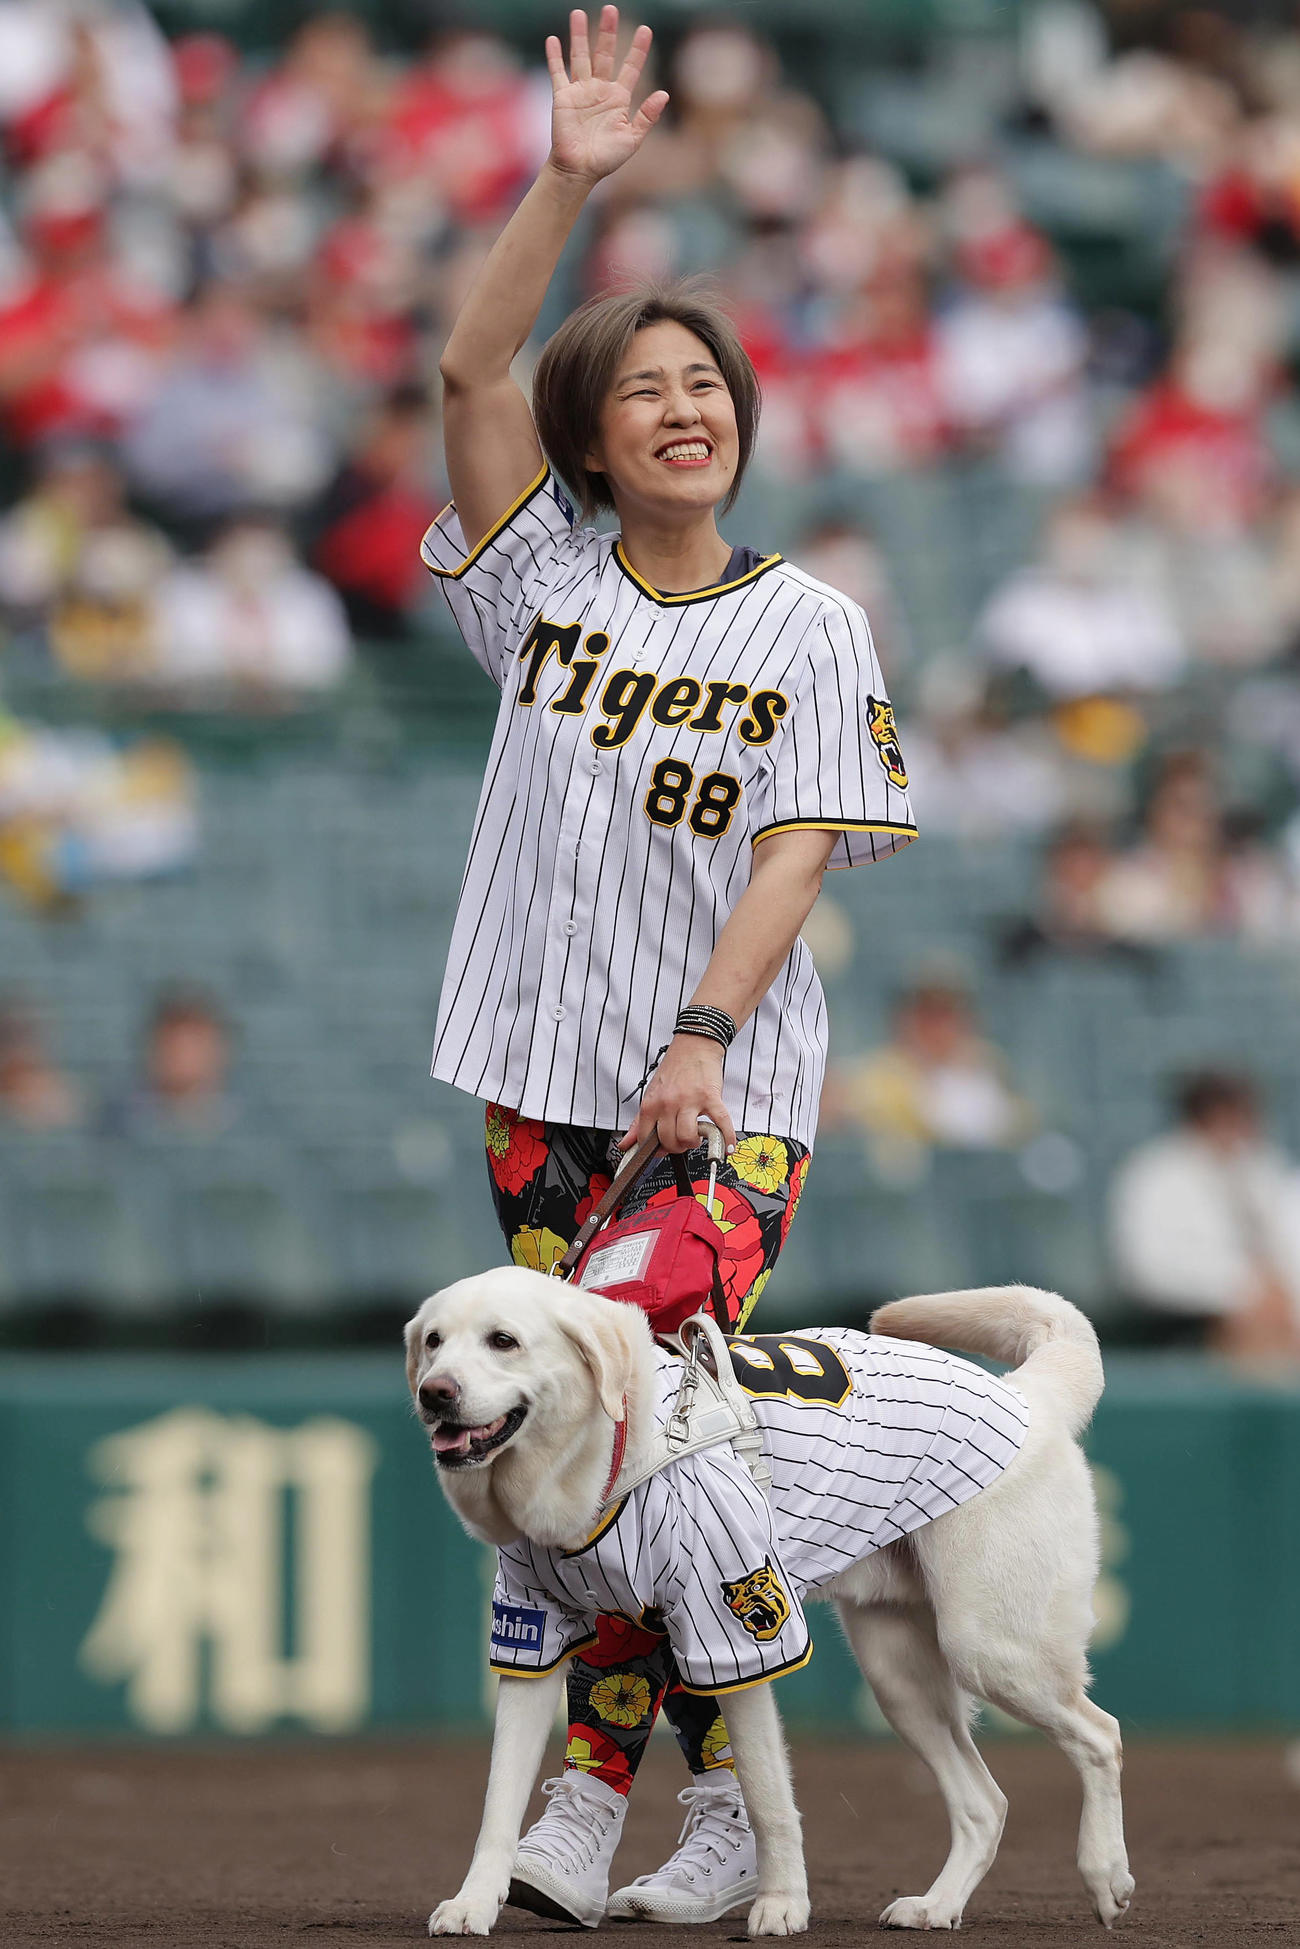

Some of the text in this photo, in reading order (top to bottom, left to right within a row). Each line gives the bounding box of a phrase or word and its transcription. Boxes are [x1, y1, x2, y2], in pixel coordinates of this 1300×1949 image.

[519, 612, 789, 750] Tigers
[643, 756, 742, 839] 88
[491, 1609, 539, 1642] shin
